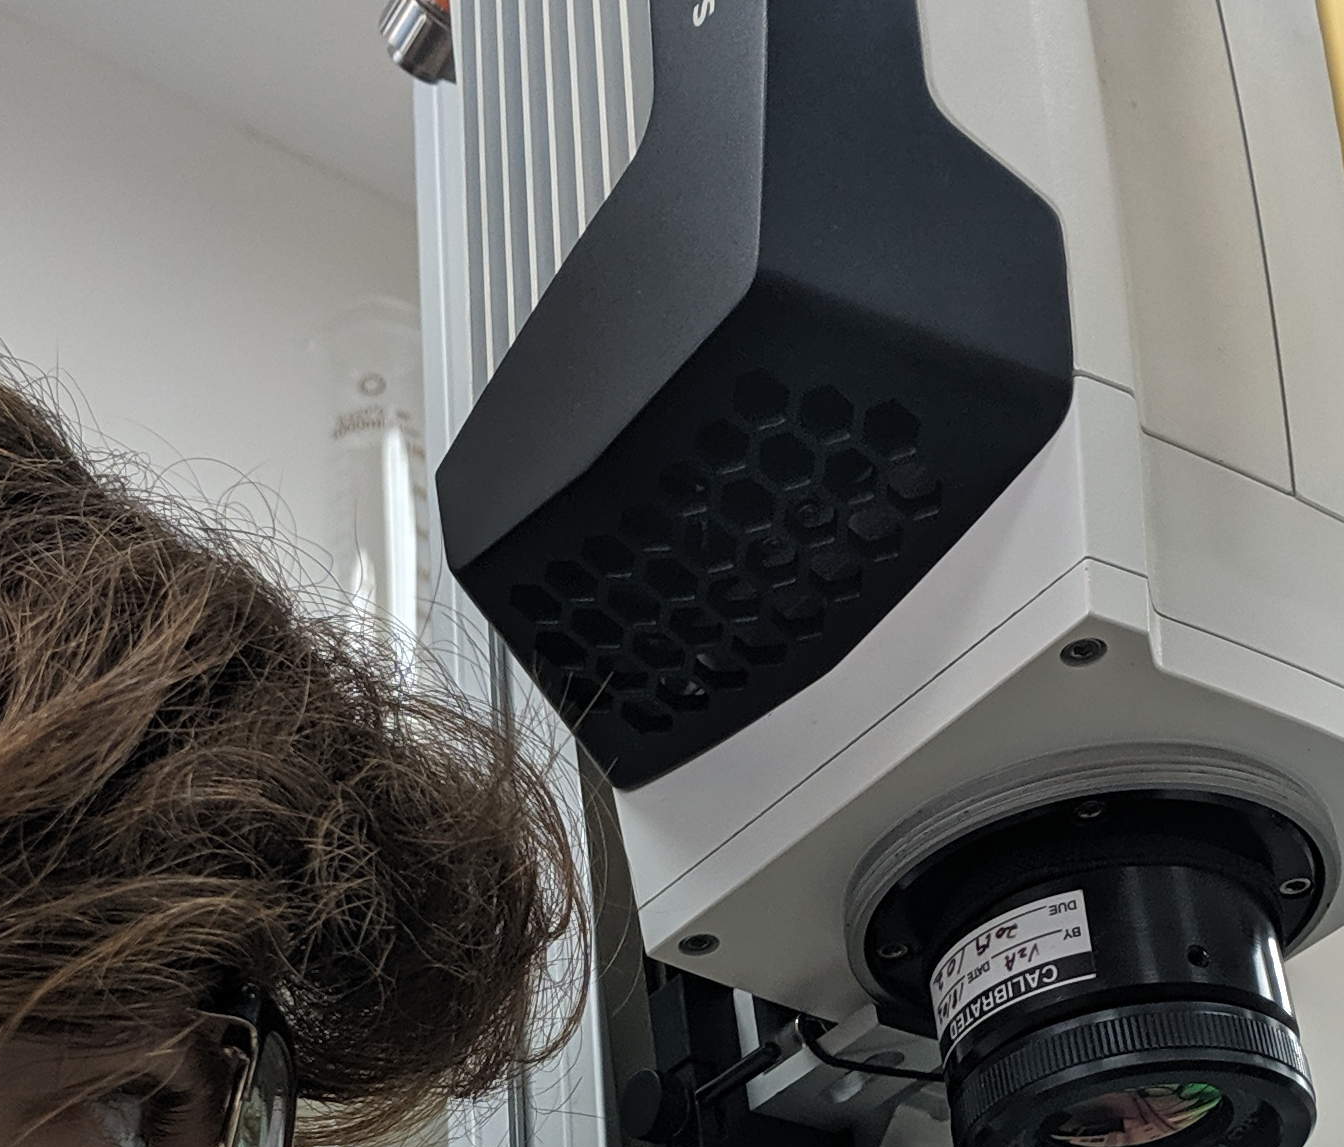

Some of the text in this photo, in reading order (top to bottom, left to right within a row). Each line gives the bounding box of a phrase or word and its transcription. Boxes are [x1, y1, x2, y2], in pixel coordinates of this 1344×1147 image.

[1048, 900, 1078, 916] DUE
[1063, 926, 1082, 940] BY
[967, 960, 991, 985] DATE
[949, 965, 1059, 1040] CALIBRATED
